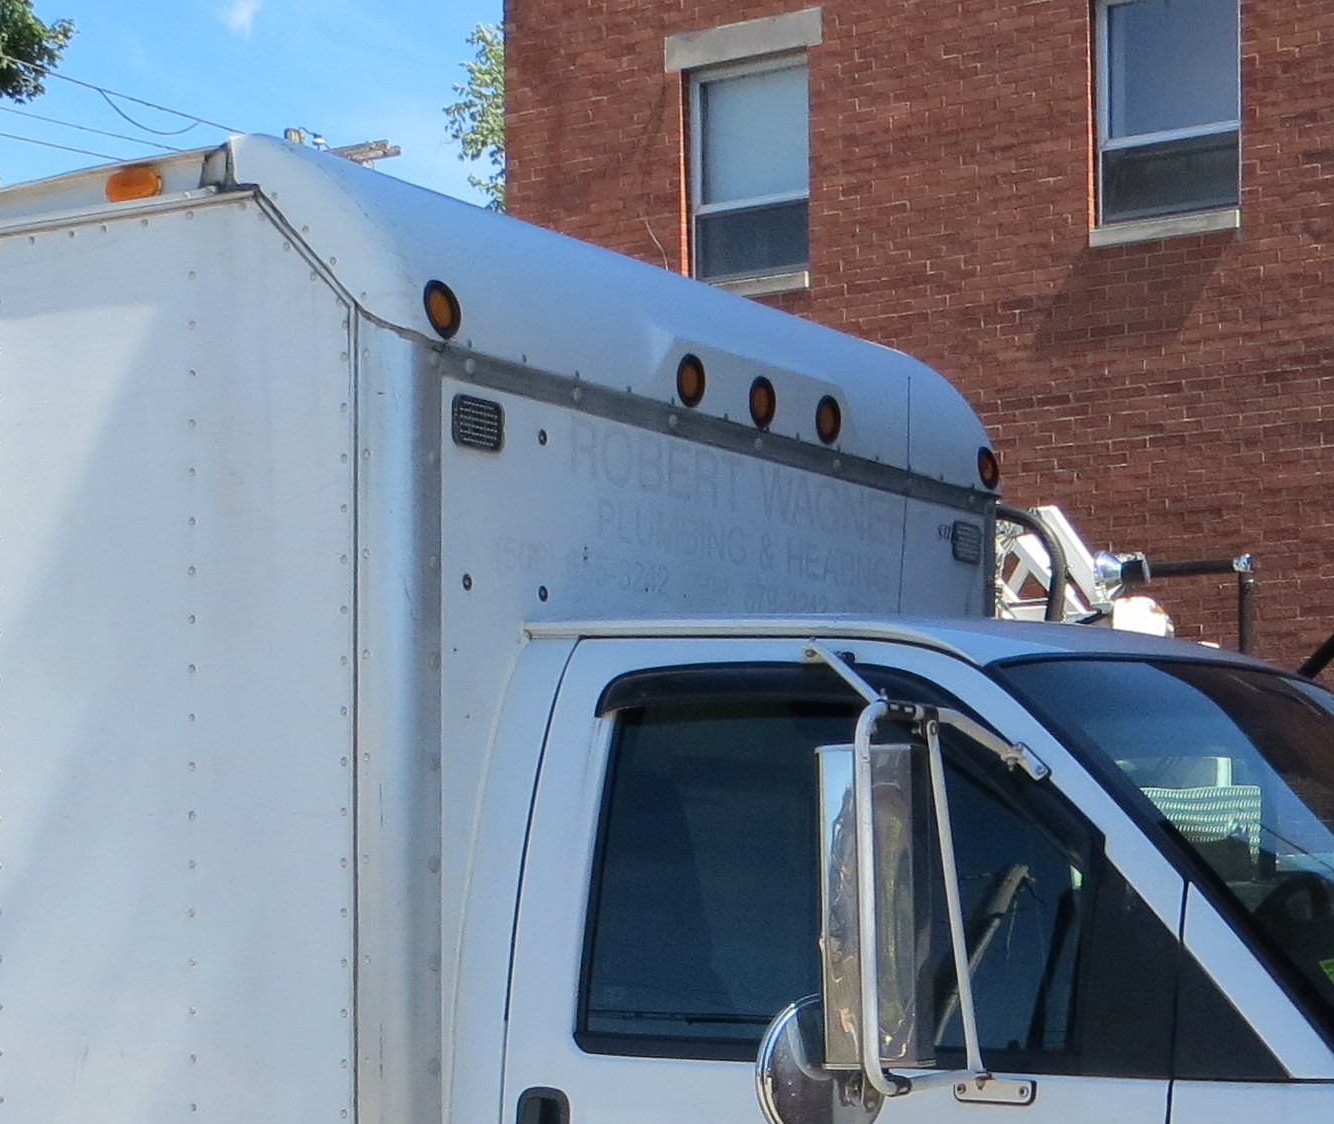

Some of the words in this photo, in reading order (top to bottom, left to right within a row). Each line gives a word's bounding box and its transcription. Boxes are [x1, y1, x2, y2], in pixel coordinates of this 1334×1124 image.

[570, 414, 744, 511] ROBERT
[597, 498, 748, 567] PLUMBING
[785, 537, 892, 595] HEATING
